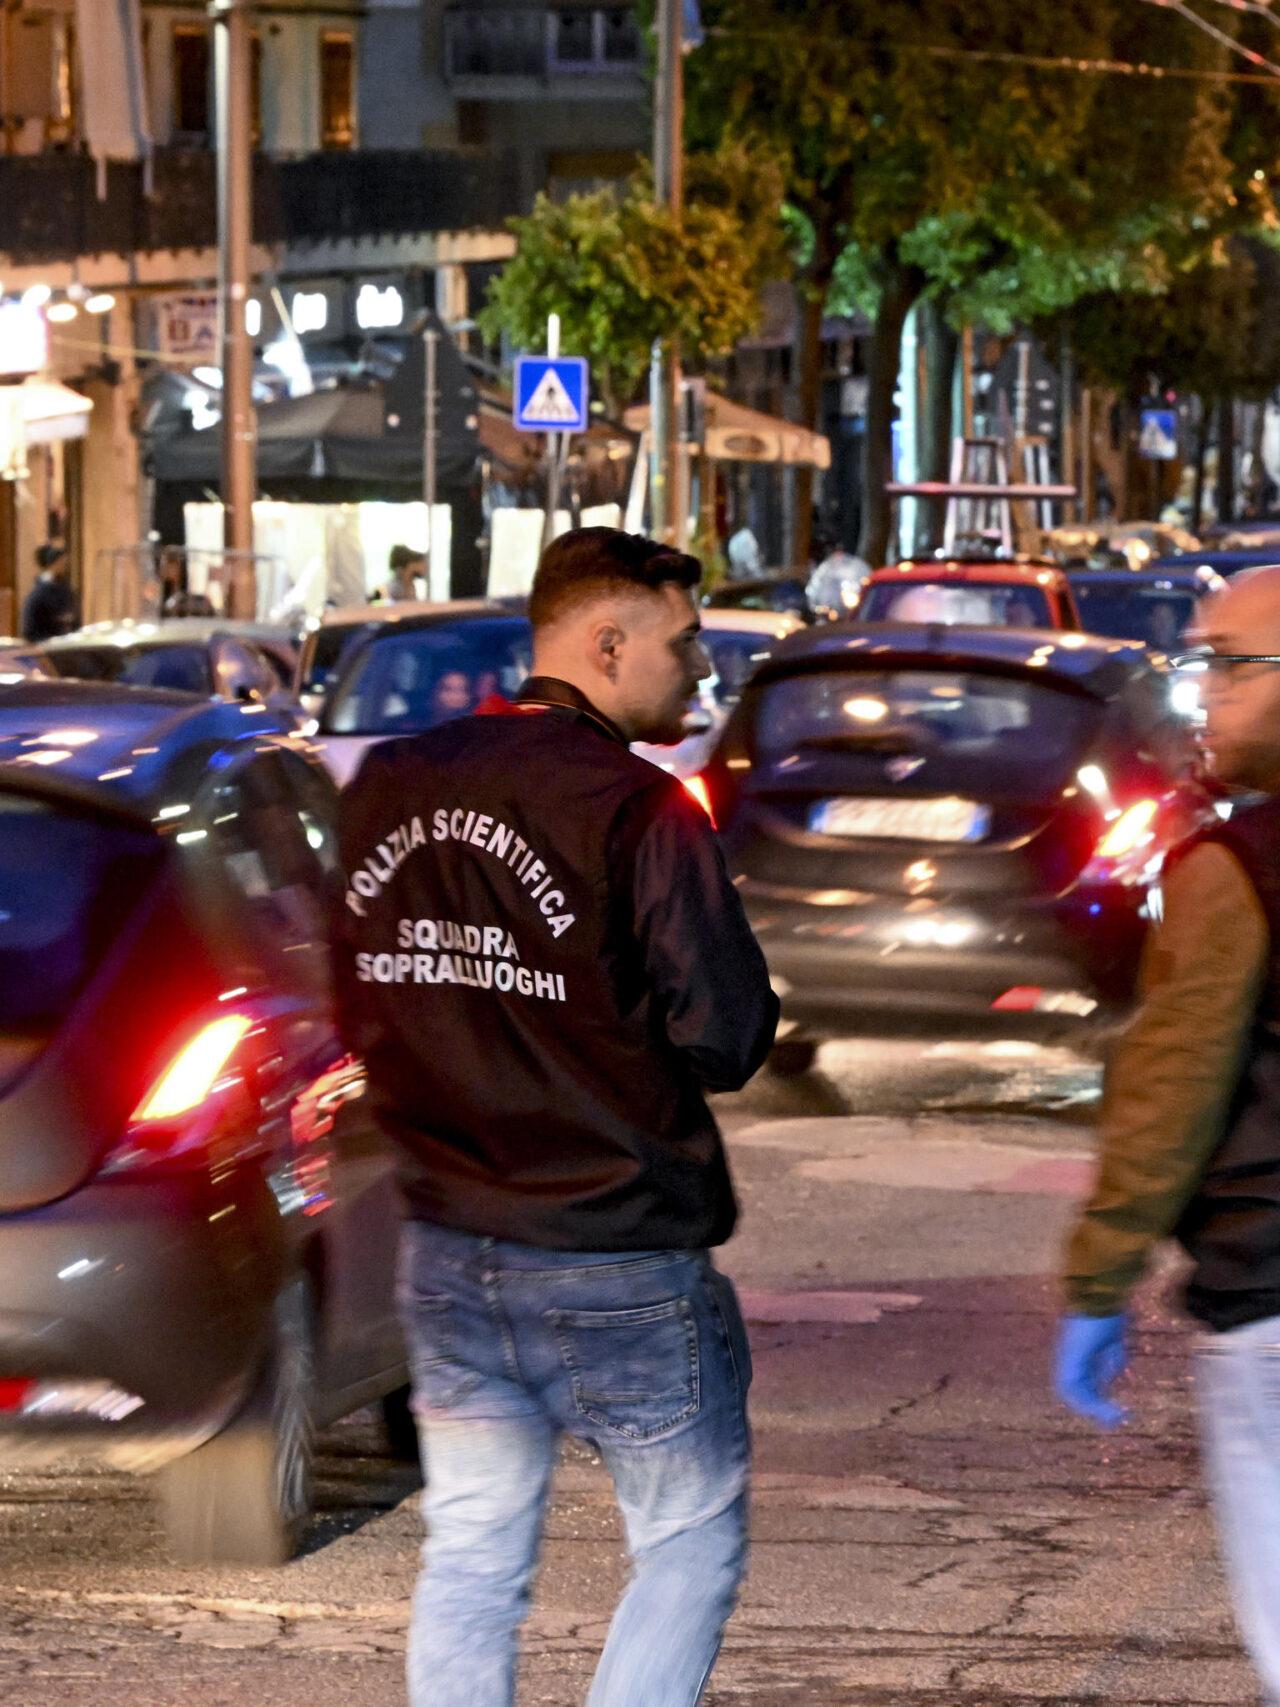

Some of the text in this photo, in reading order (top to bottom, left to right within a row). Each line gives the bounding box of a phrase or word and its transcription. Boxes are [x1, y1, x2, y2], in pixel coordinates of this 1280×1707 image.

[345, 808, 576, 939] POLIZIA SCIENTIFICA
[397, 918, 520, 961] SQUADRA
[355, 953, 567, 1001] SOPRALLUOGHI
